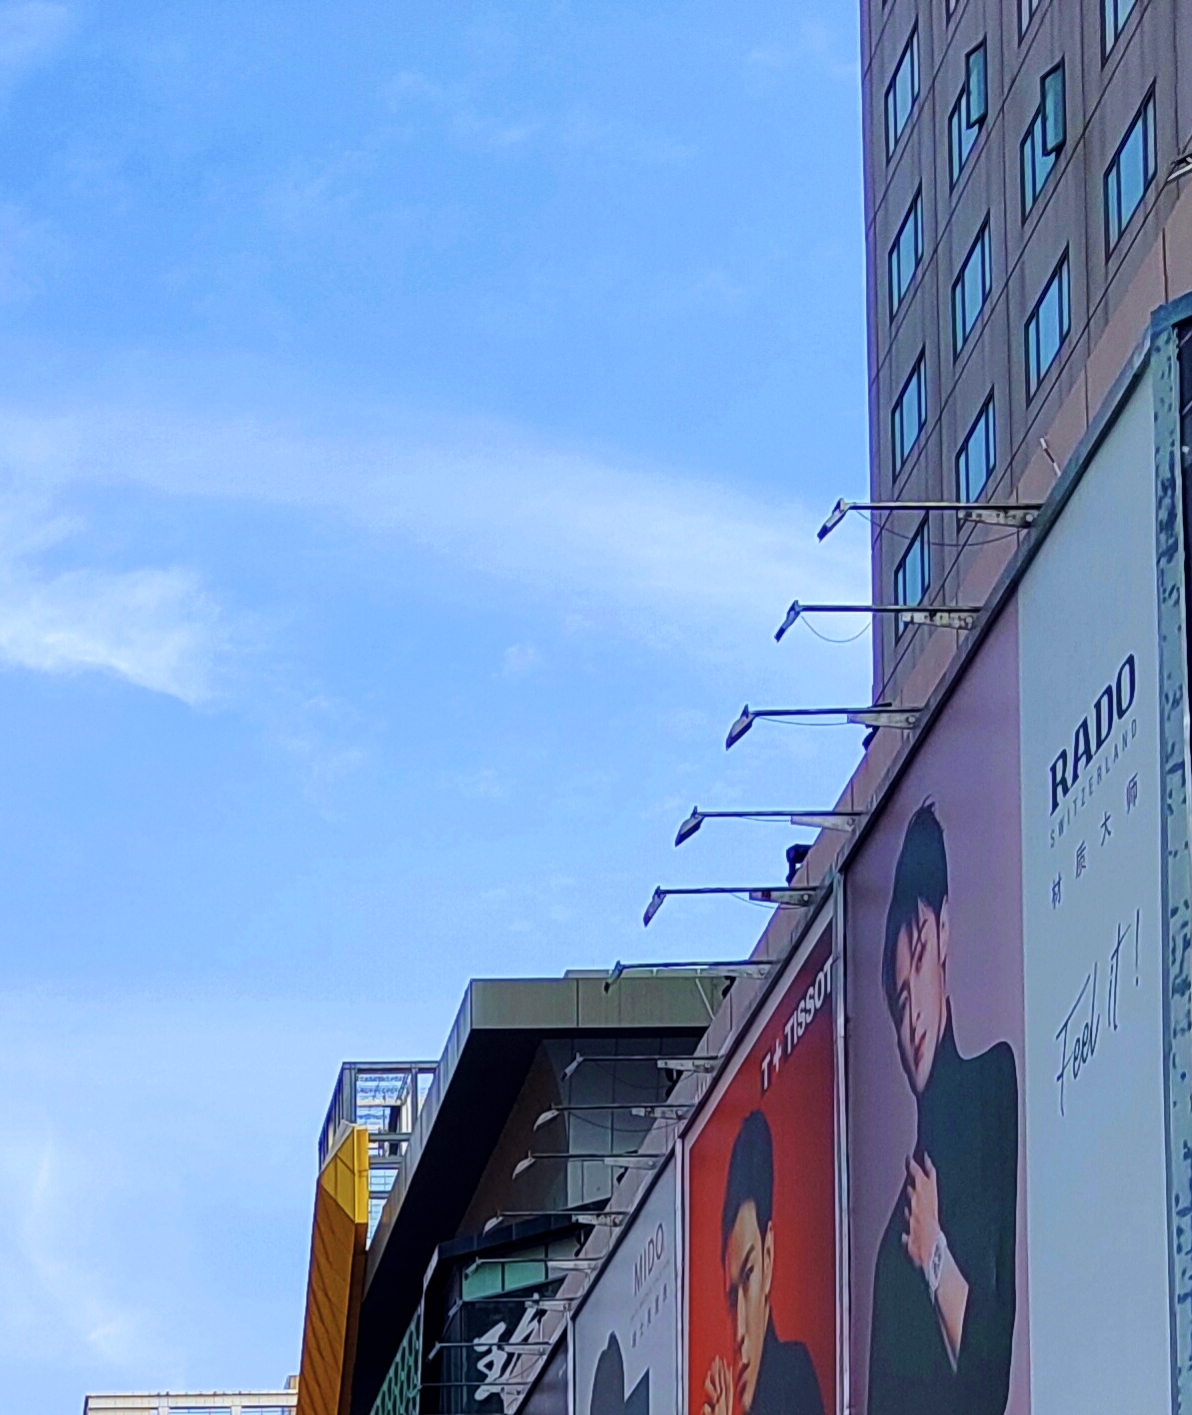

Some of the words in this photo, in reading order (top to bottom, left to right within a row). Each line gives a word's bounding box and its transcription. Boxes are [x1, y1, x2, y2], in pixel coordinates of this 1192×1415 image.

[1049, 653, 1136, 818] RADO
[1050, 718, 1138, 849] SWITZERLAND
[783, 954, 833, 1055] TISSOT
[1056, 960, 1101, 1117] Feel
[633, 1221, 665, 1298] MIDO
